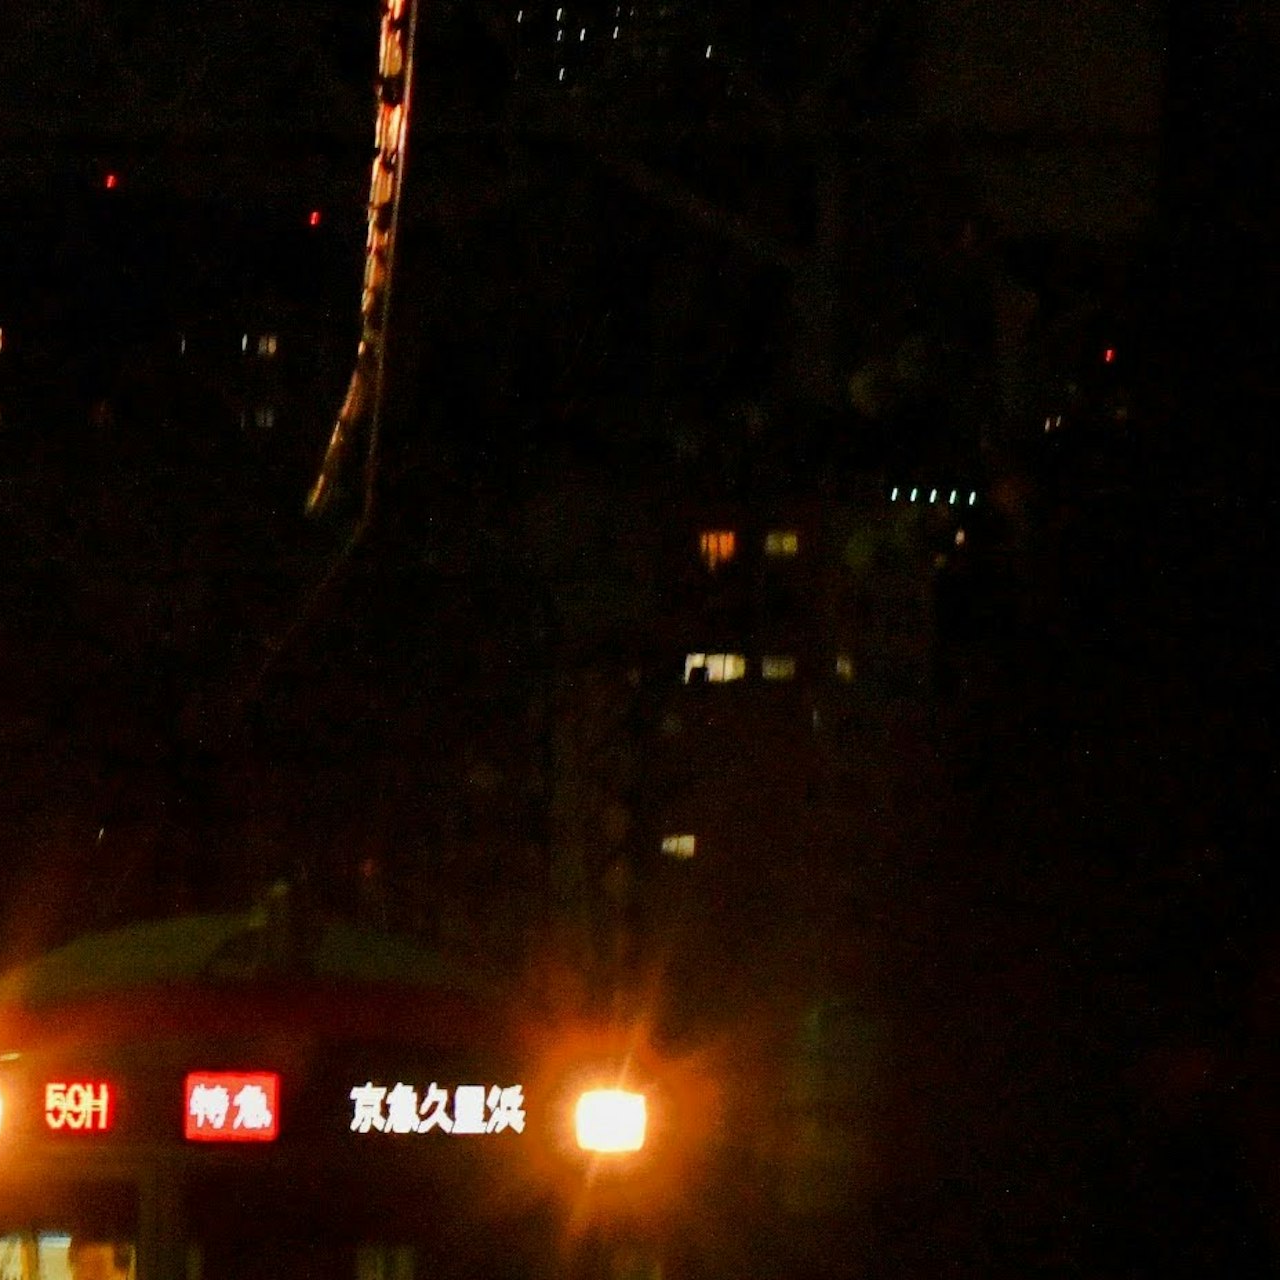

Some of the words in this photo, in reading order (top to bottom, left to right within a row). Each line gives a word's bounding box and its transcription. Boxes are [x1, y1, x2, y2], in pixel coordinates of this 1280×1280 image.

[45, 1083, 108, 1128] 59H
[190, 1084, 272, 1129] 特急
[350, 1081, 526, 1133] 京急久里浜
